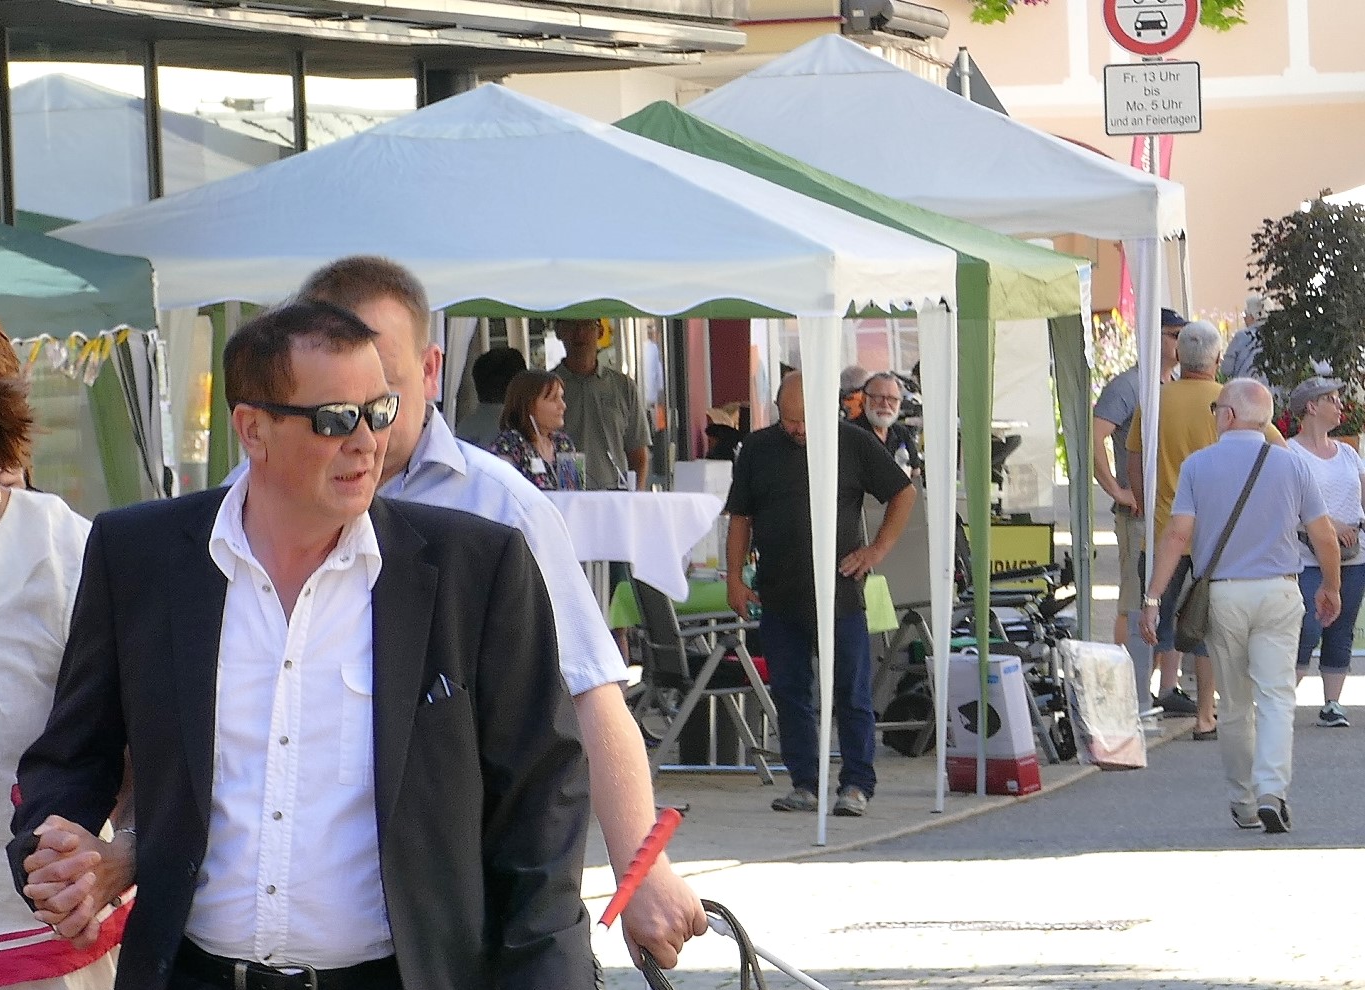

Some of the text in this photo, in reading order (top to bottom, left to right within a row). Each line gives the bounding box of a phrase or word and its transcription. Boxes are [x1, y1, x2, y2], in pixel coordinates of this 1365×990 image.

[1122, 70, 1181, 84] Fr. 13 Uhr
[1143, 86, 1161, 97] bis
[1126, 99, 1183, 112] Mo. 5 Uhr
[1110, 113, 1197, 127] und an Feiertagen
